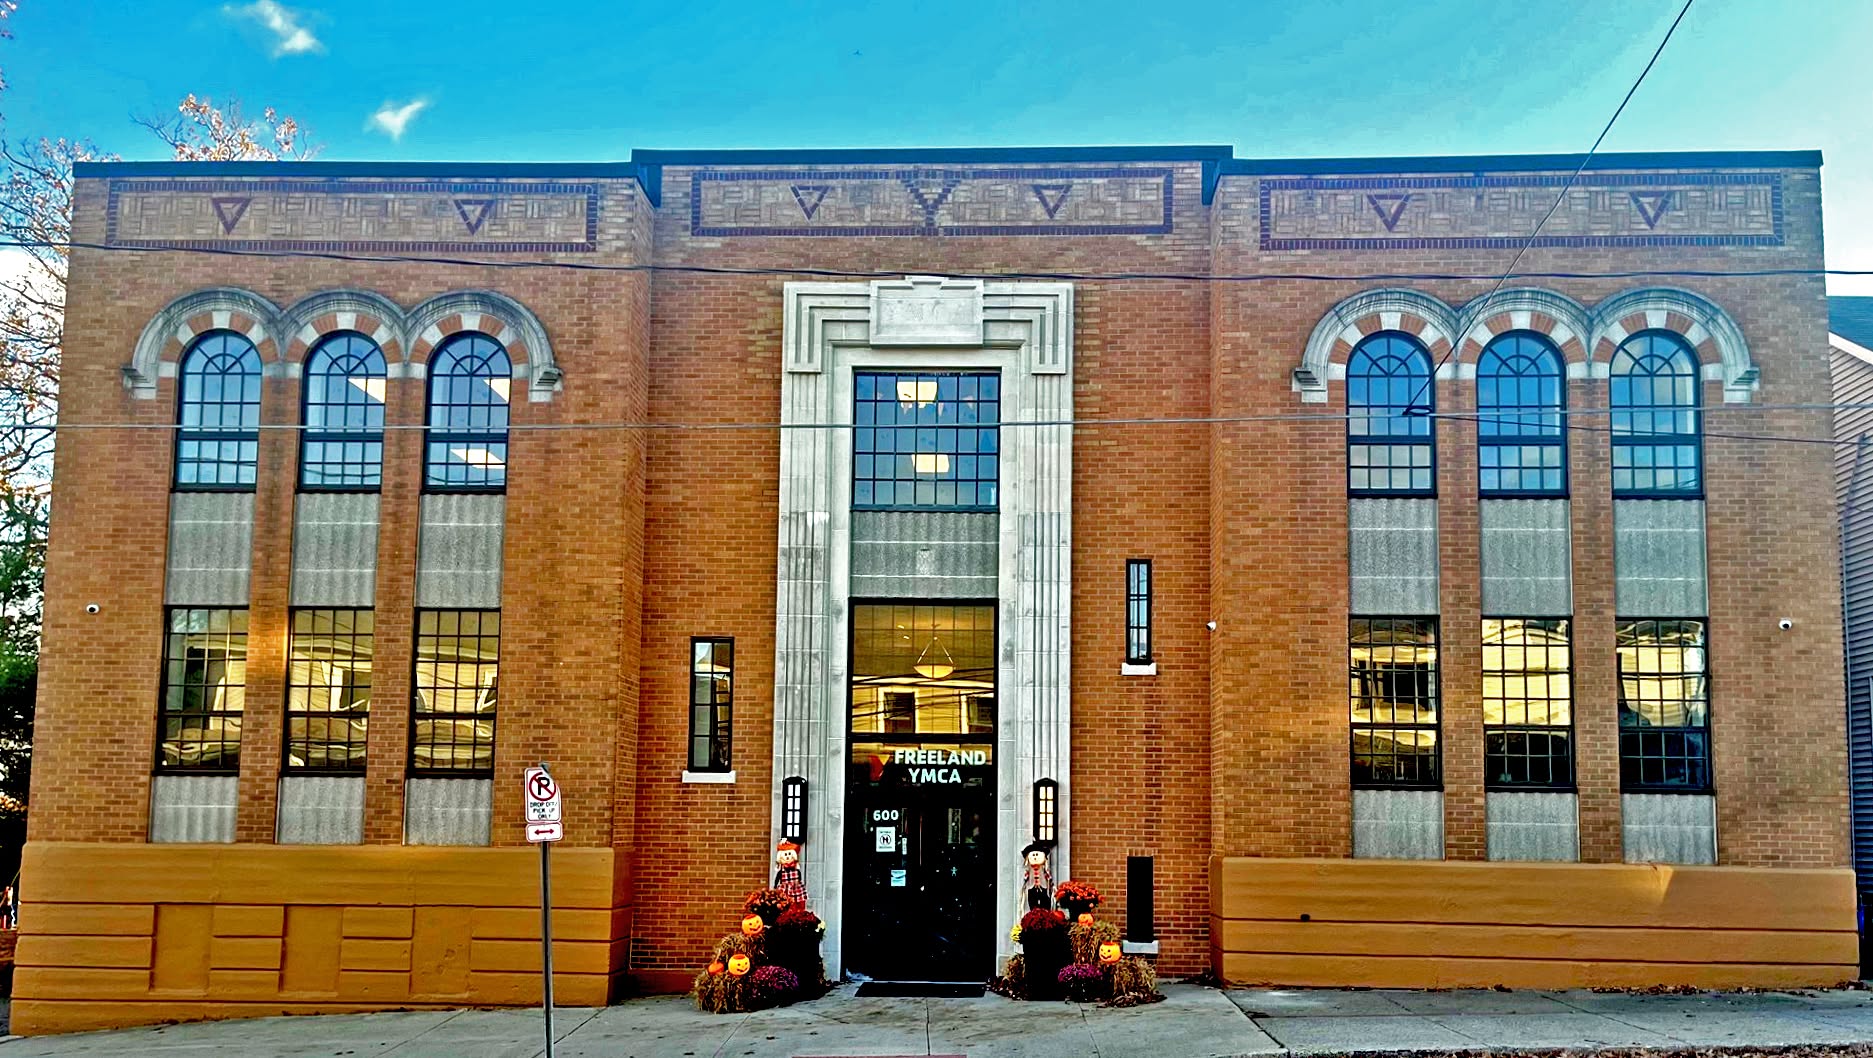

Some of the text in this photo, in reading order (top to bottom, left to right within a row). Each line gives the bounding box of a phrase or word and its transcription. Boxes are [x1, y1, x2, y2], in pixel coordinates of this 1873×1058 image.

[895, 750, 986, 765] FREELAND
[908, 768, 962, 783] YMCA
[873, 809, 899, 821] 600
